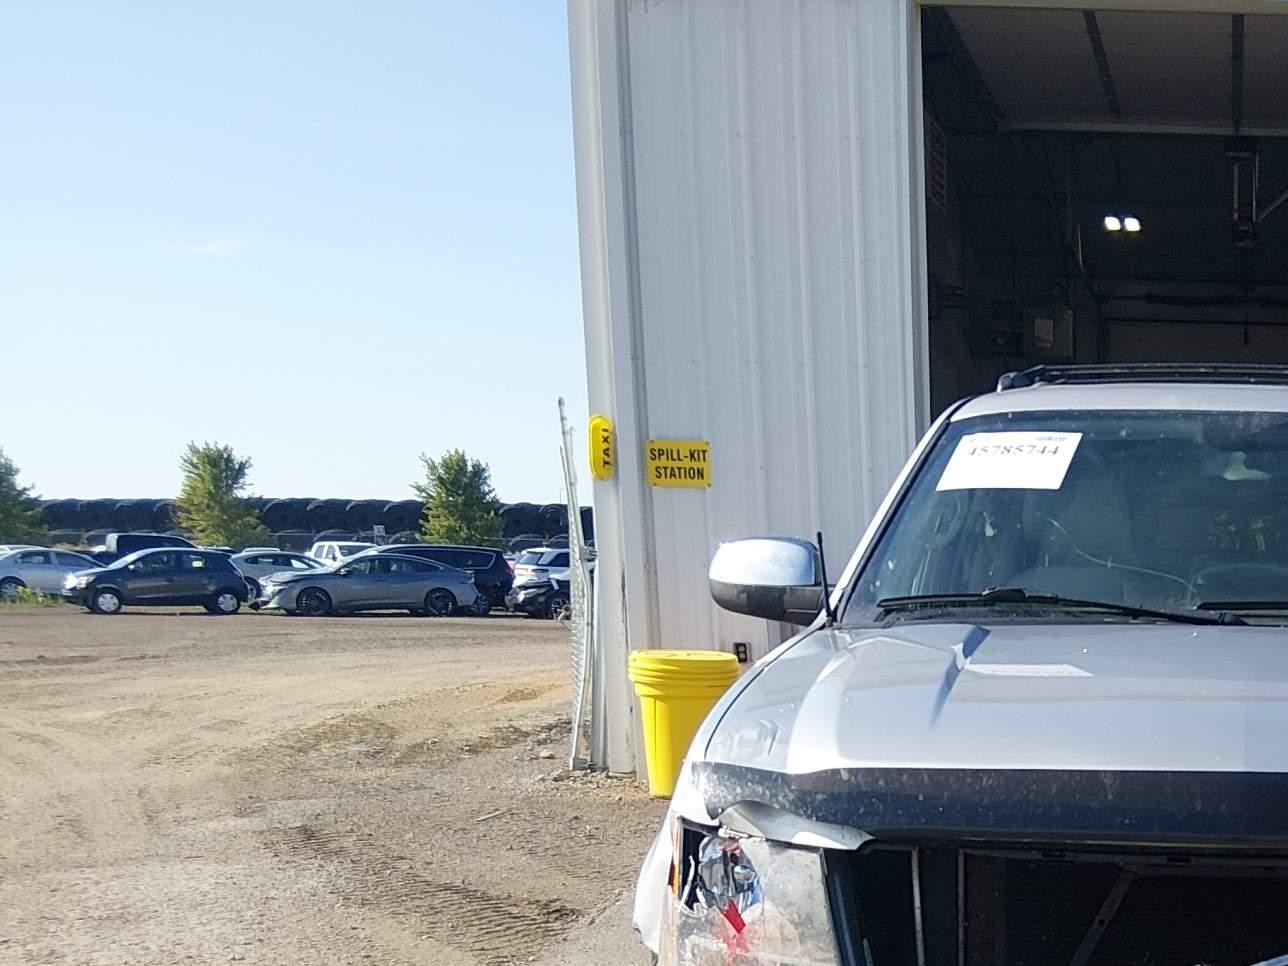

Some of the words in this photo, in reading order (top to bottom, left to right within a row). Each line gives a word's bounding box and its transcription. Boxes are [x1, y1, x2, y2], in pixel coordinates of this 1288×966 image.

[601, 428, 612, 468] TAXI
[649, 447, 709, 463] SPILL-KIT
[968, 445, 1061, 456] 45785744
[655, 466, 705, 480] STATION
